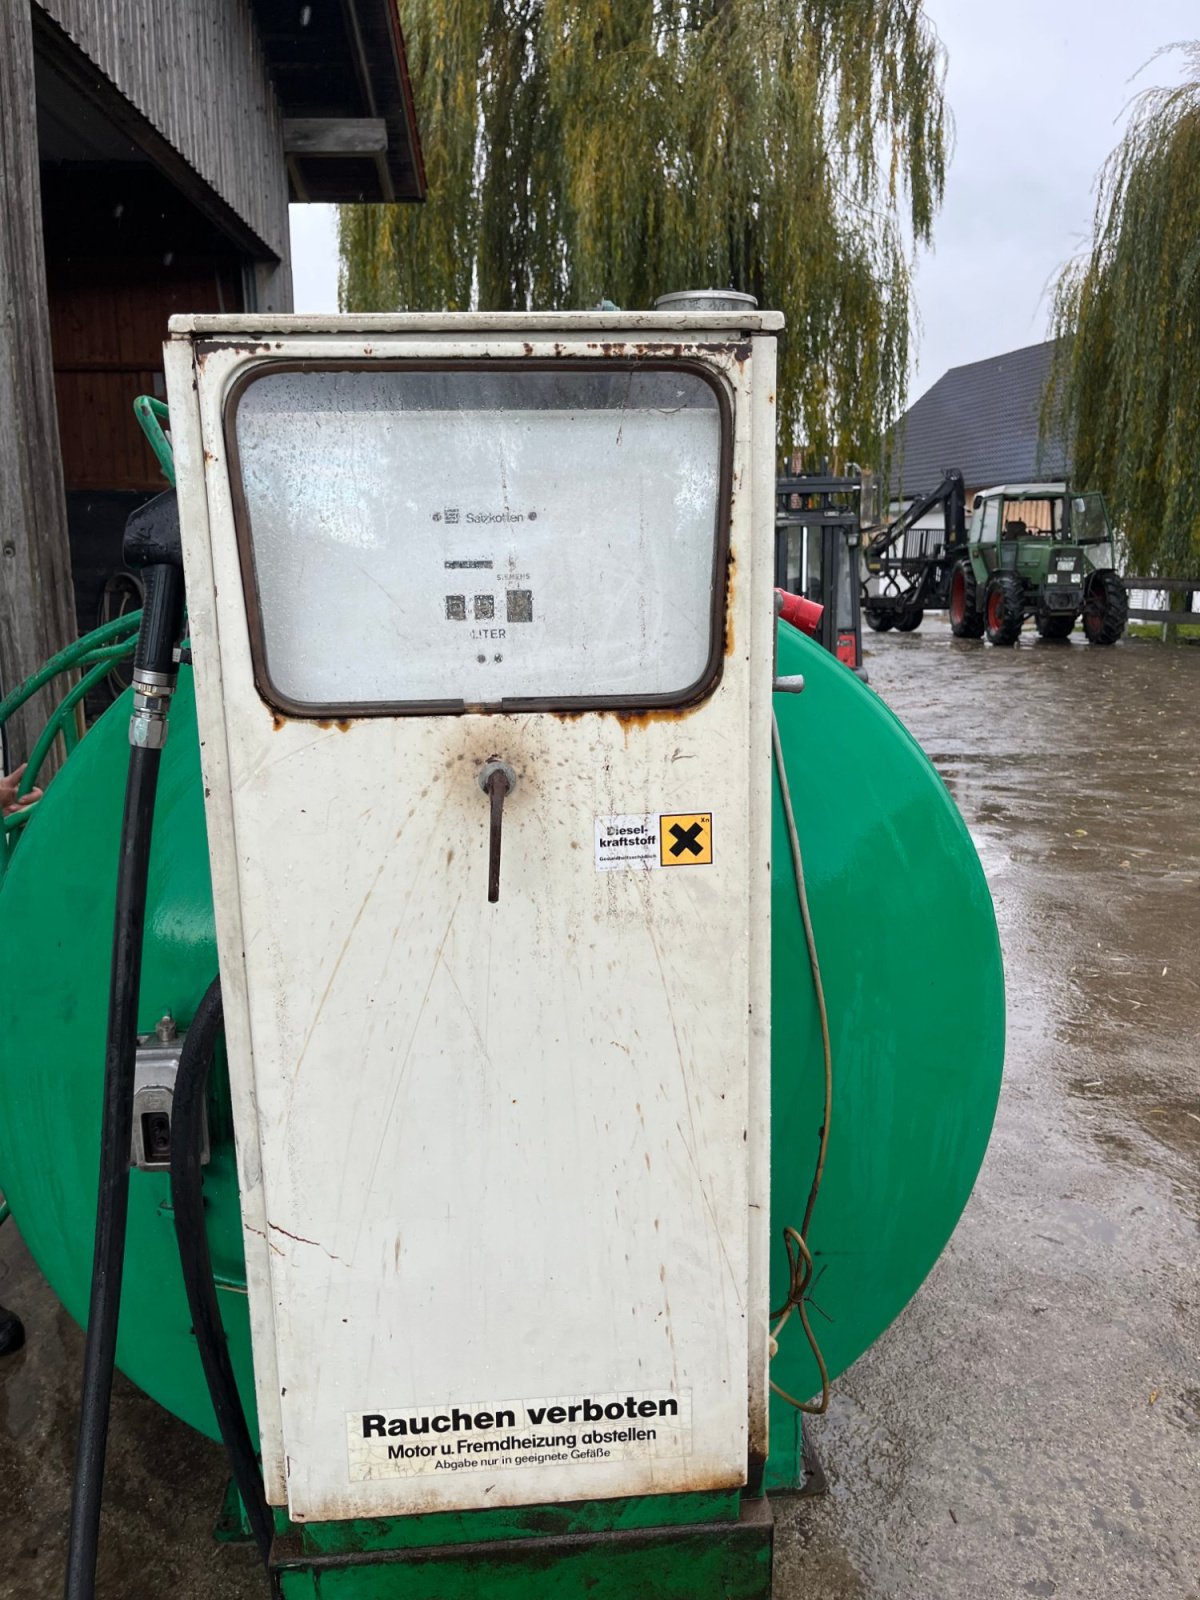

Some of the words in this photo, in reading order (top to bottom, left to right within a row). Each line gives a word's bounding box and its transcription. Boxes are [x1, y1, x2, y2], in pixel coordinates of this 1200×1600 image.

[471, 629, 506, 639] LITER
[606, 825, 648, 836] Diesel-
[599, 835, 656, 848] kraftstoff
[362, 1408, 515, 1438] Rauchen
[527, 1396, 678, 1425] verboten
[388, 1444, 437, 1459] Motor
[441, 1444, 454, 1456] u.
[457, 1434, 577, 1454] Fremdheizung
[581, 1427, 657, 1445] abstellen
[434, 1458, 478, 1471] Abgabe
[480, 1458, 499, 1467] nur
[502, 1455, 512, 1465] in
[515, 1451, 568, 1465] geeignete
[570, 1448, 611, 1460] Gefäße
